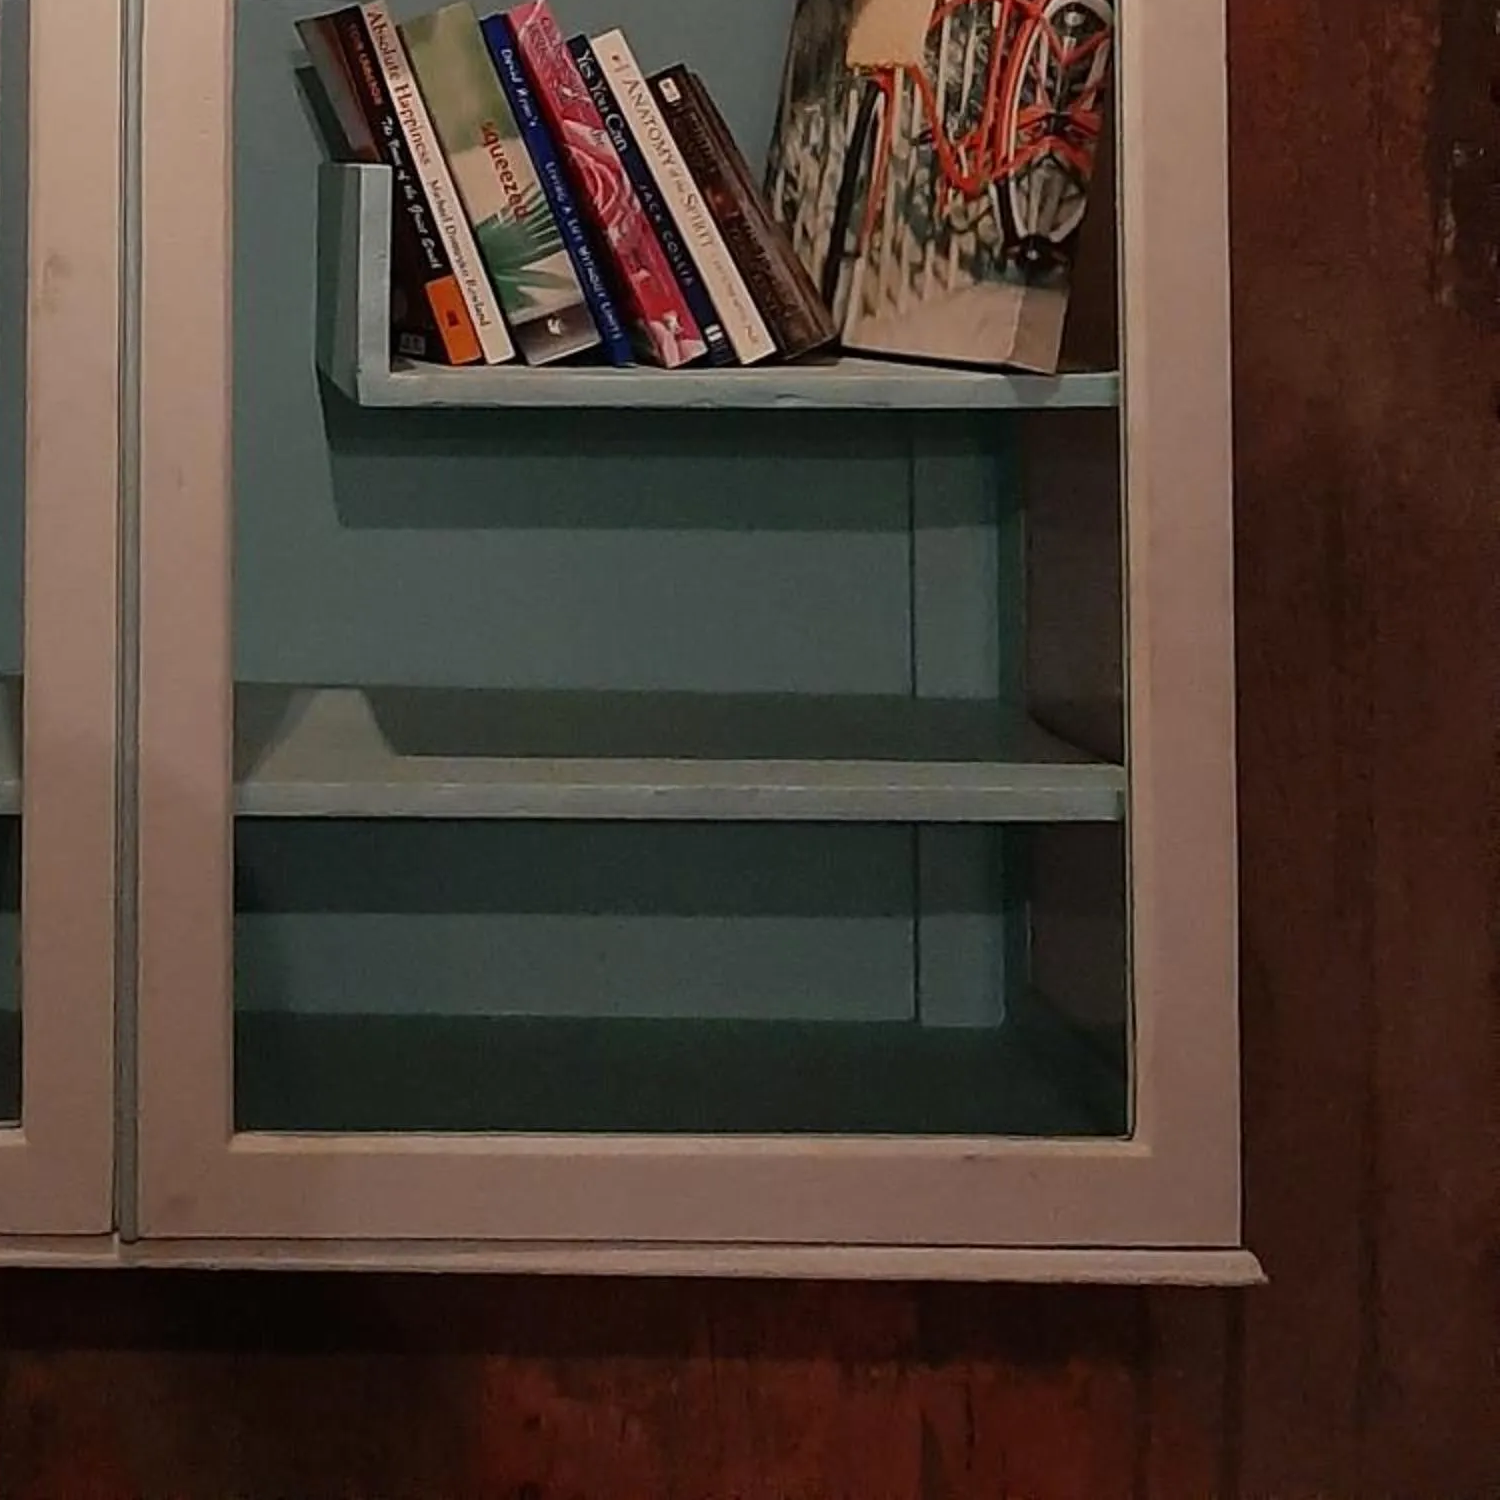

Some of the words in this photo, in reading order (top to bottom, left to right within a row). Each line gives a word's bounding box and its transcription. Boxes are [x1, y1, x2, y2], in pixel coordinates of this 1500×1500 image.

[365, 6, 404, 83] Absolute
[393, 81, 435, 166] Happiness
[573, 48, 600, 80] Yes
[587, 78, 615, 113] You
[602, 110, 635, 152] Can
[477, 120, 532, 221] squeezed
[618, 73, 680, 171] ANATOMY
[676, 190, 719, 249] SPIRIT
[636, 180, 666, 224] JACK
